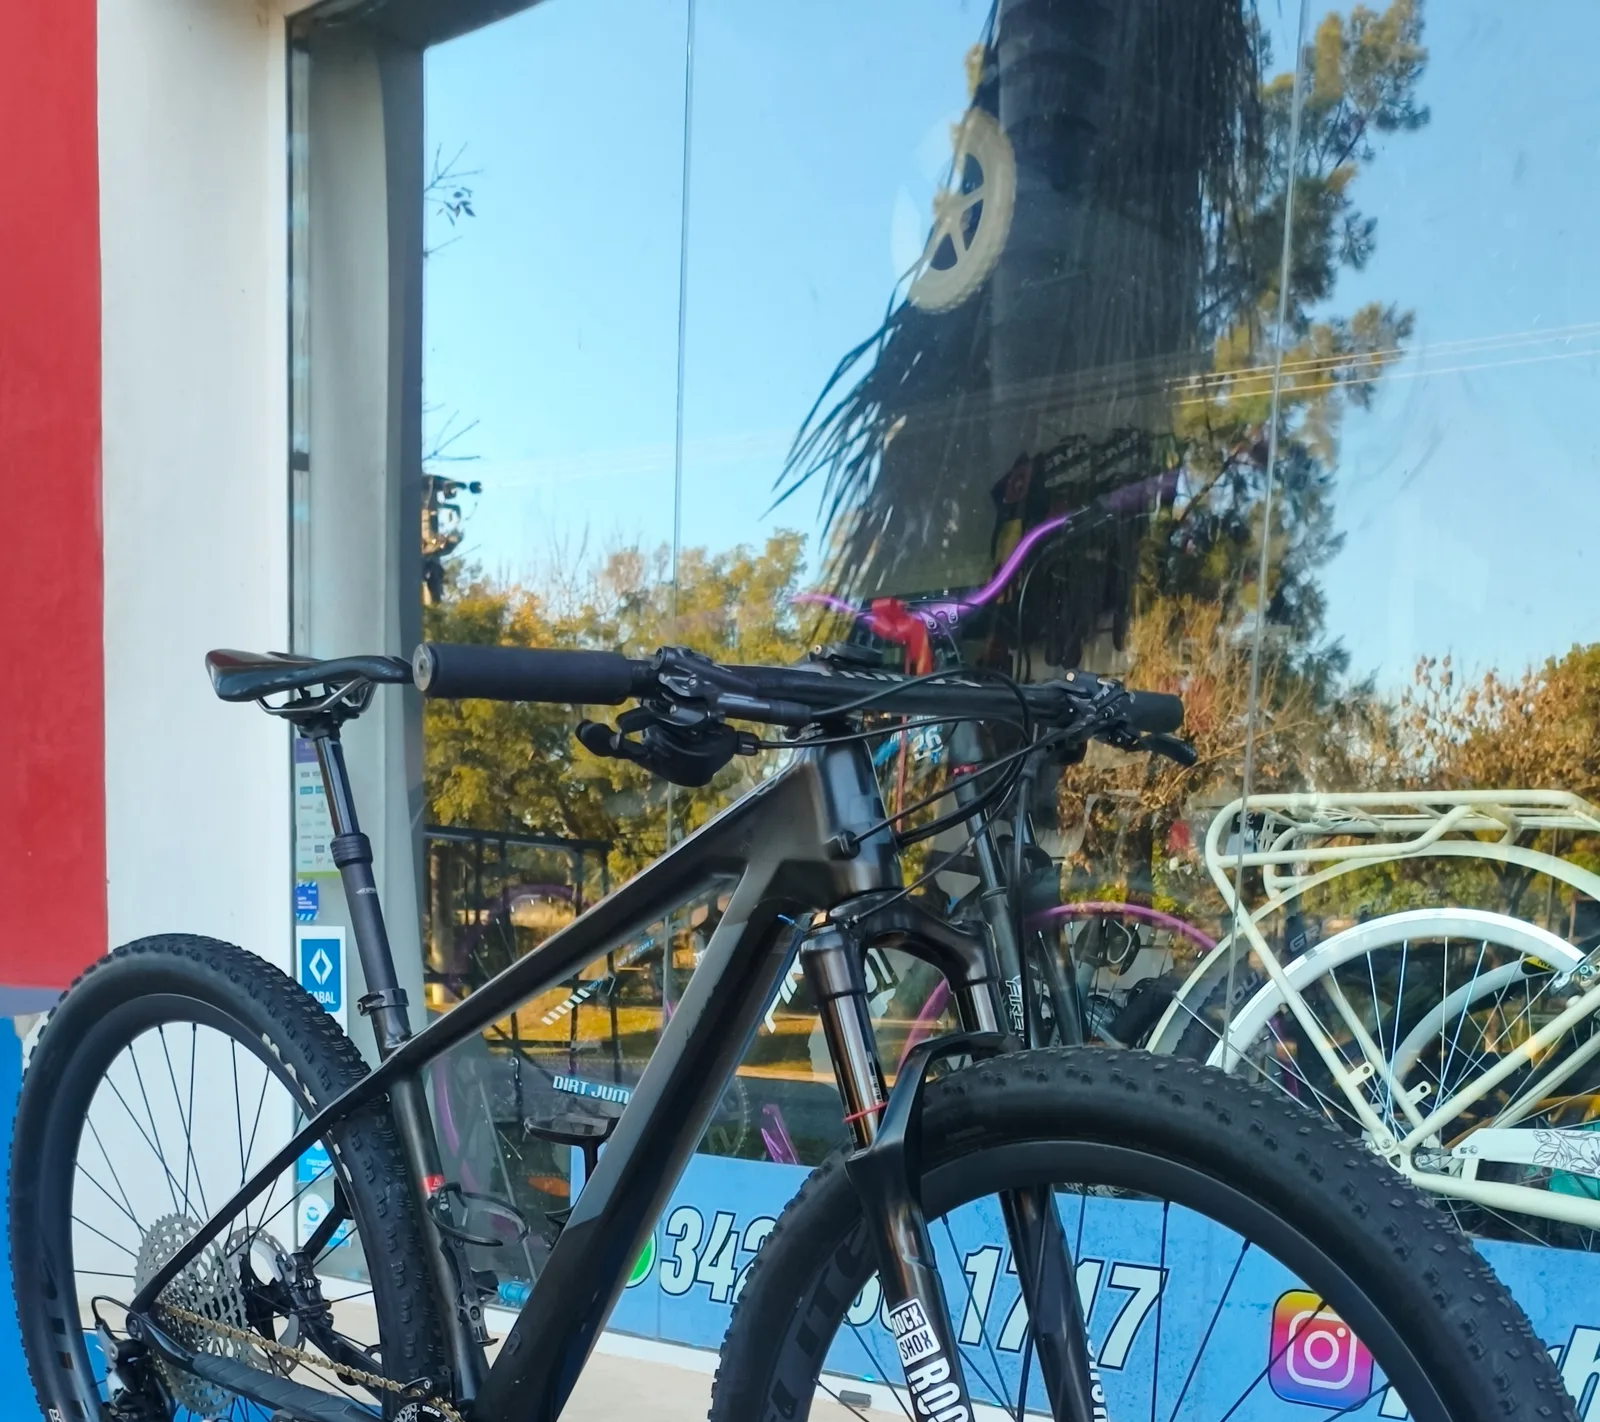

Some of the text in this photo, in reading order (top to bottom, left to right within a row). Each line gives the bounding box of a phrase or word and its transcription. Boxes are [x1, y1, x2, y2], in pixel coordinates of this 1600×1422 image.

[552, 1075, 635, 1106] DIRT JUM
[890, 1303, 925, 1340] ROCK
[900, 1327, 935, 1362] SHOX
